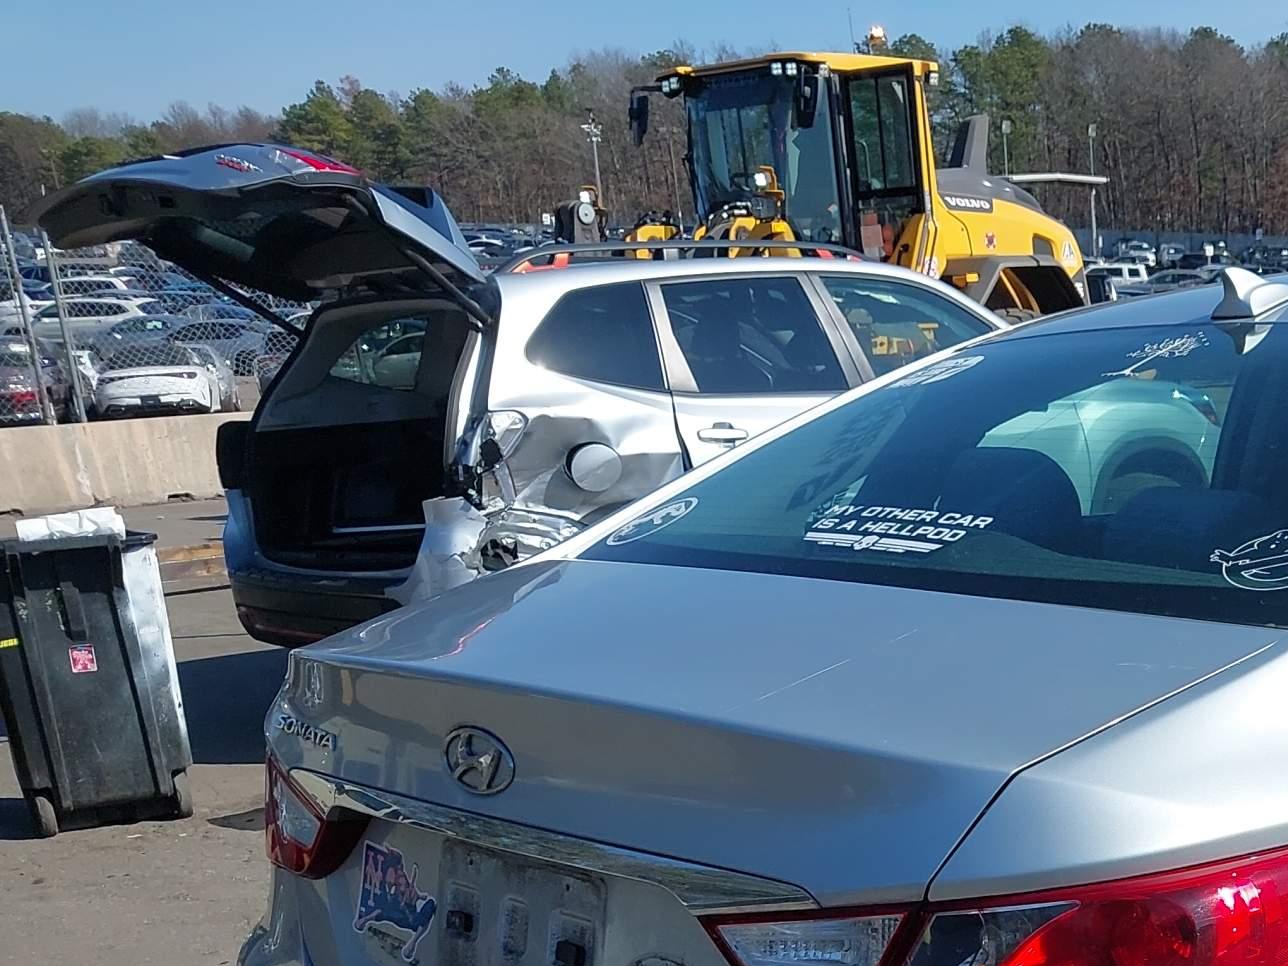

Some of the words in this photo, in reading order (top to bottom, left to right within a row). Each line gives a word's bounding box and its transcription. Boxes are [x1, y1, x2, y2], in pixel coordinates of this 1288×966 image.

[944, 196, 990, 209] VOLVO
[824, 505, 864, 516] MY
[861, 506, 939, 521] OTHER
[937, 513, 994, 528] CAR
[812, 518, 840, 528] IS
[836, 519, 857, 530] A
[859, 520, 967, 542] HELLPOD
[272, 714, 336, 750] SONATA
